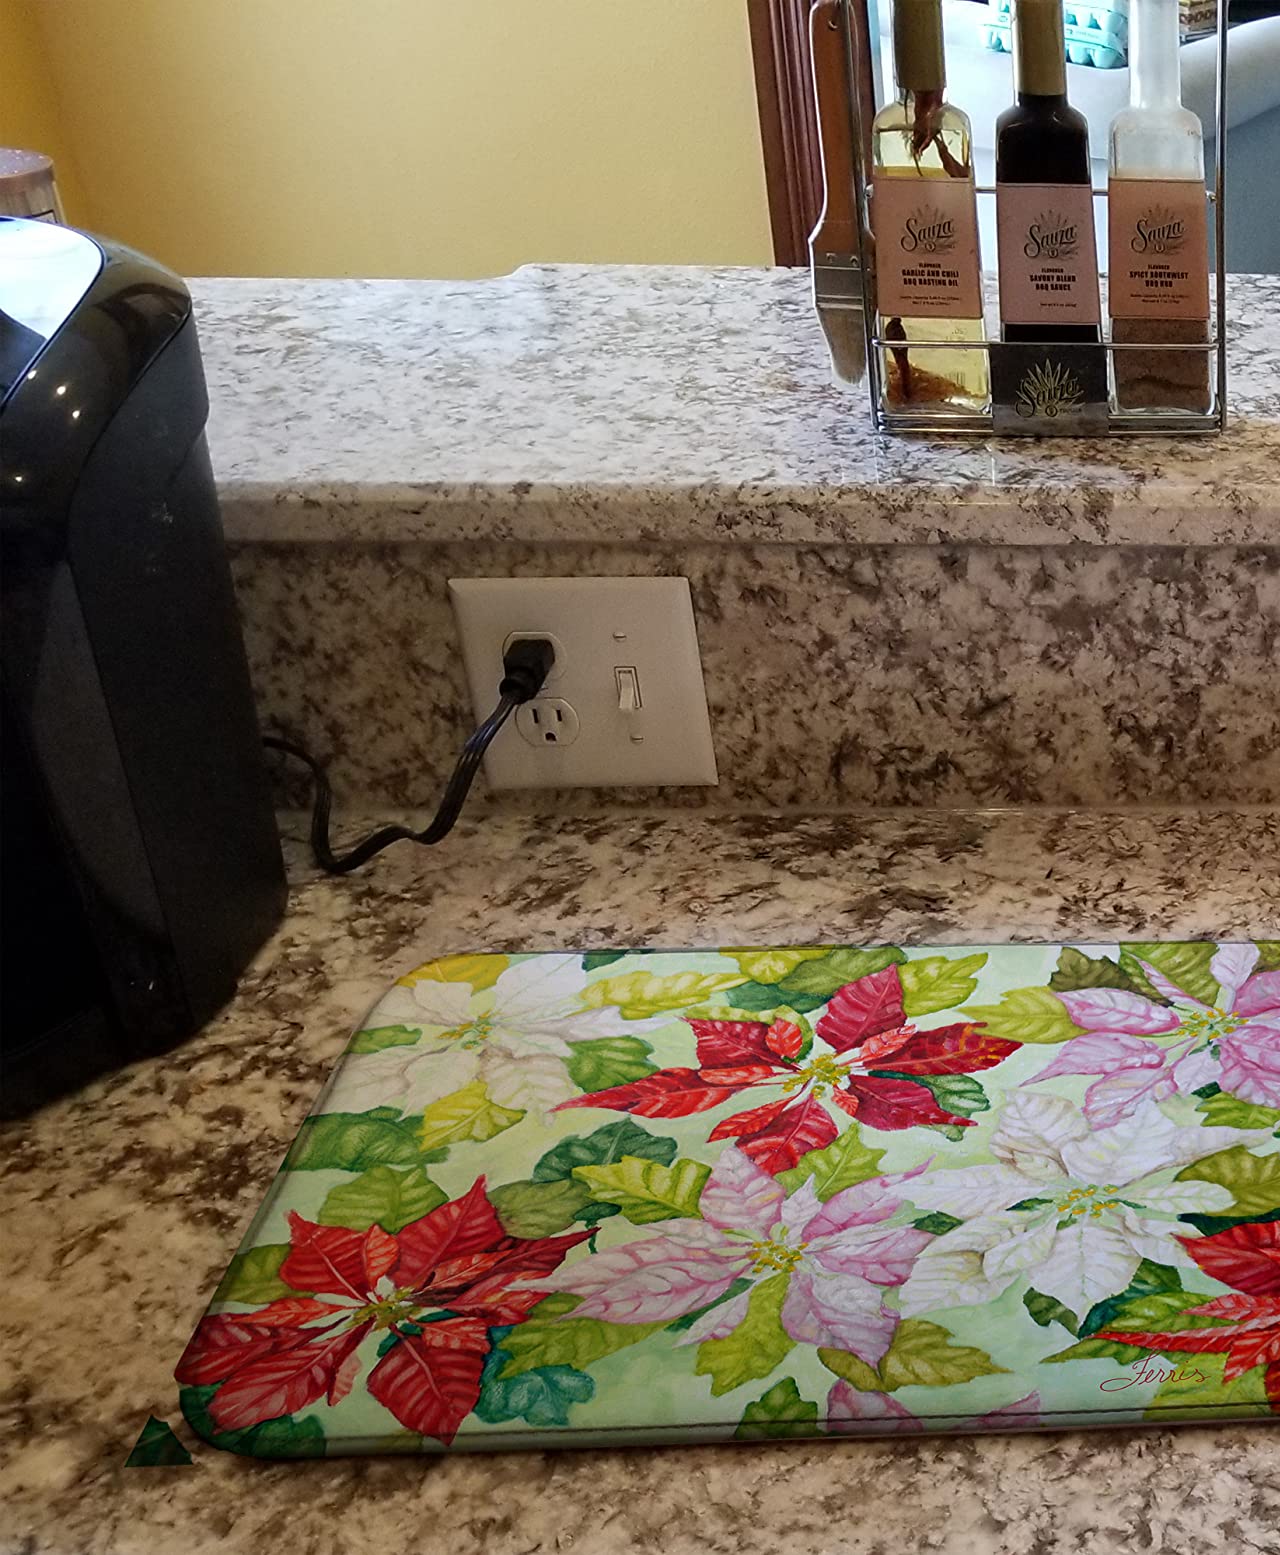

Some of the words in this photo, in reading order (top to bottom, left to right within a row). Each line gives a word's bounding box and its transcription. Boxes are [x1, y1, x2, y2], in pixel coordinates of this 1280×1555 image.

[900, 217, 954, 252] Sauza
[1131, 218, 1184, 254] Sauza
[1024, 224, 1077, 258] Sauza
[901, 269, 926, 277] GARLIC
[926, 269, 940, 277] AND
[941, 270, 960, 278] CHILI
[1129, 271, 1149, 279] SPICY
[1150, 271, 1189, 280] SOUTHWEST
[918, 278, 947, 287] BASTING
[948, 279, 959, 287] OIL
[1029, 274, 1055, 282] SAVORY
[1055, 275, 1077, 283] BLEND
[1050, 283, 1071, 291] SAUCE
[1099, 1348, 1211, 1393] Ferris
